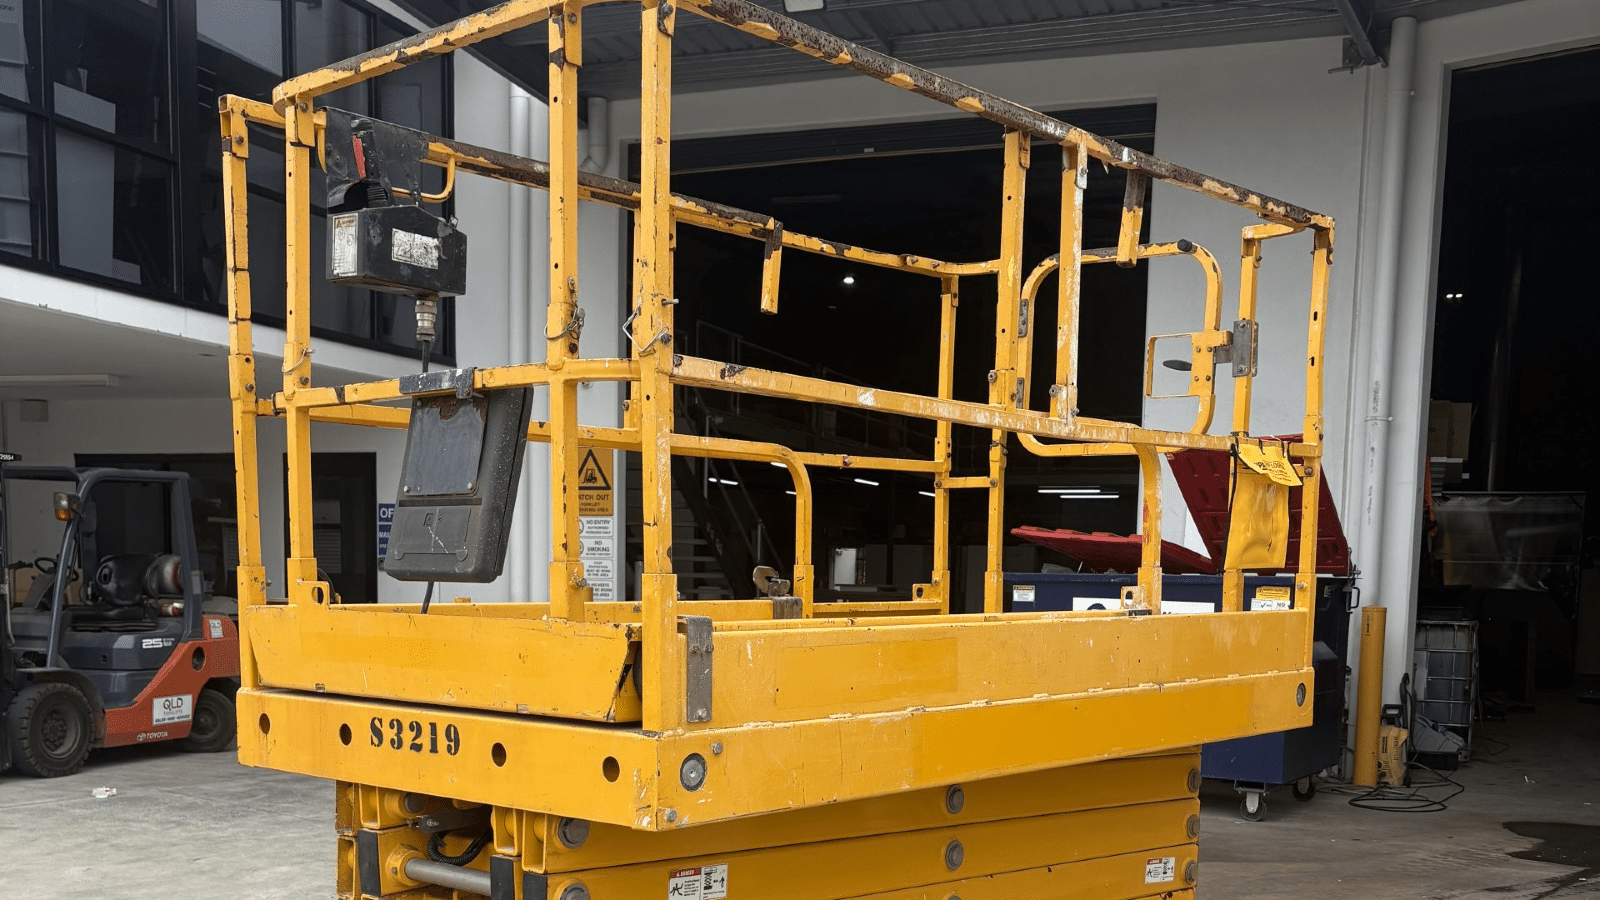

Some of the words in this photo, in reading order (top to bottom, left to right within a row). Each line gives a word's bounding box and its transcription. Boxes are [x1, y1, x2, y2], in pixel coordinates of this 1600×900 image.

[142, 638, 163, 649] 25
[163, 698, 184, 711] QLD
[146, 731, 168, 739] TOYOTA
[370, 716, 461, 756] S3219
